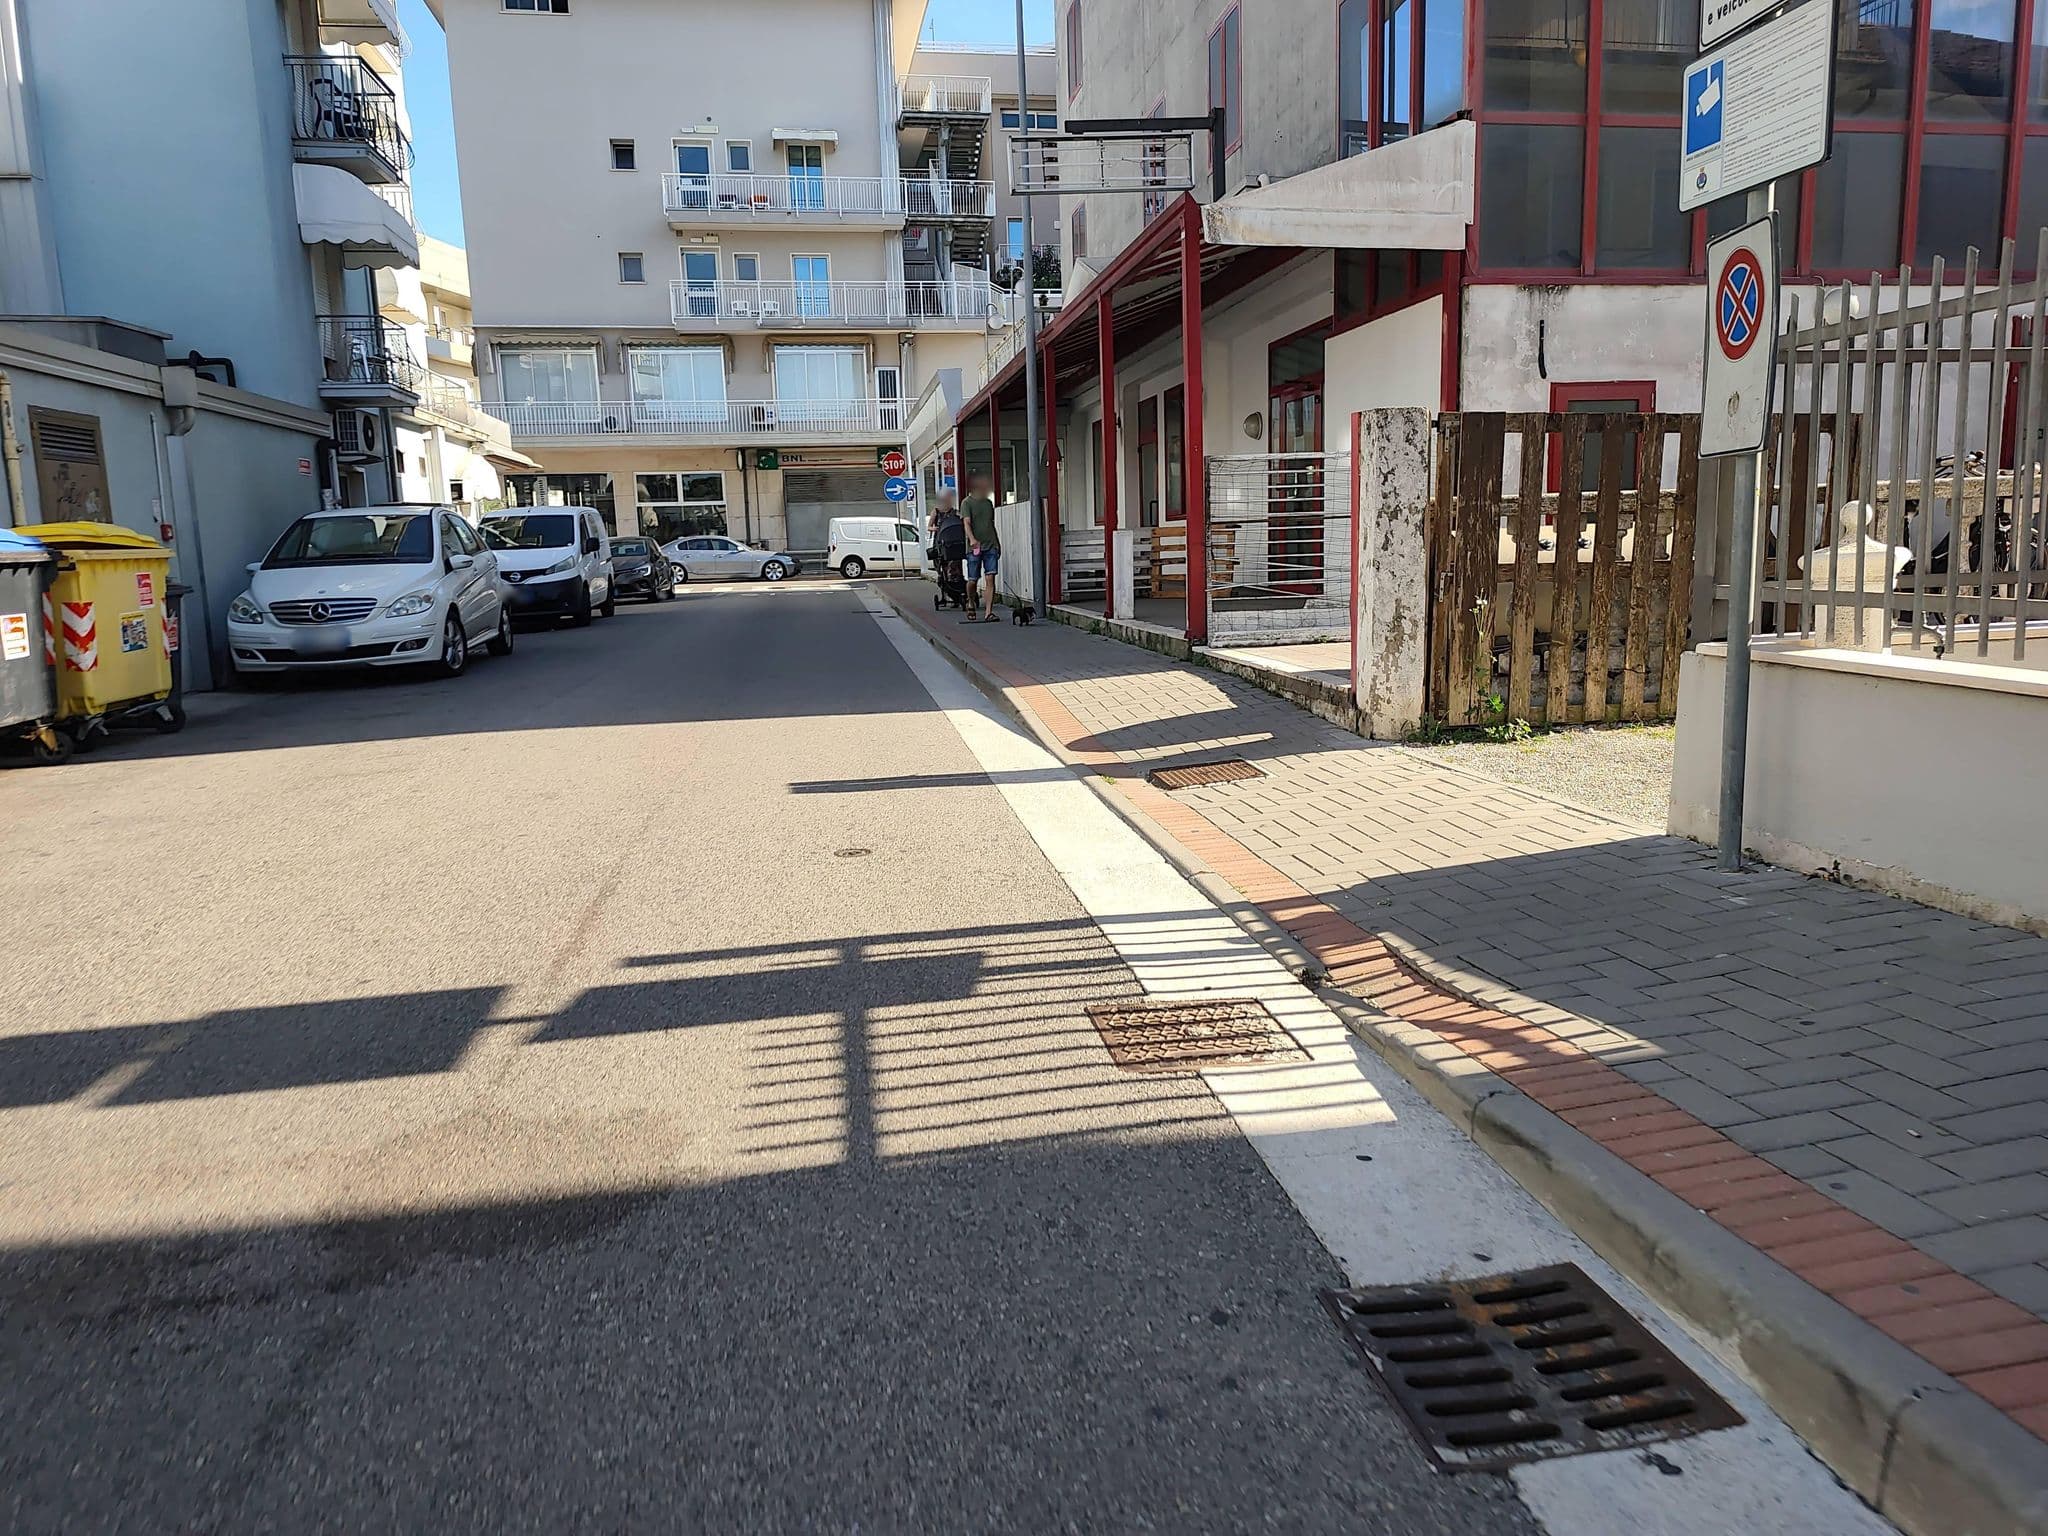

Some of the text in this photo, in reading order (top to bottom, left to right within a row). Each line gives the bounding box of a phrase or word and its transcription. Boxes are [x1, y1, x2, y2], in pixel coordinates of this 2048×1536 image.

[1707, 13, 1714, 26] e
[782, 454, 805, 463] BNL
[883, 459, 905, 470] STOP
